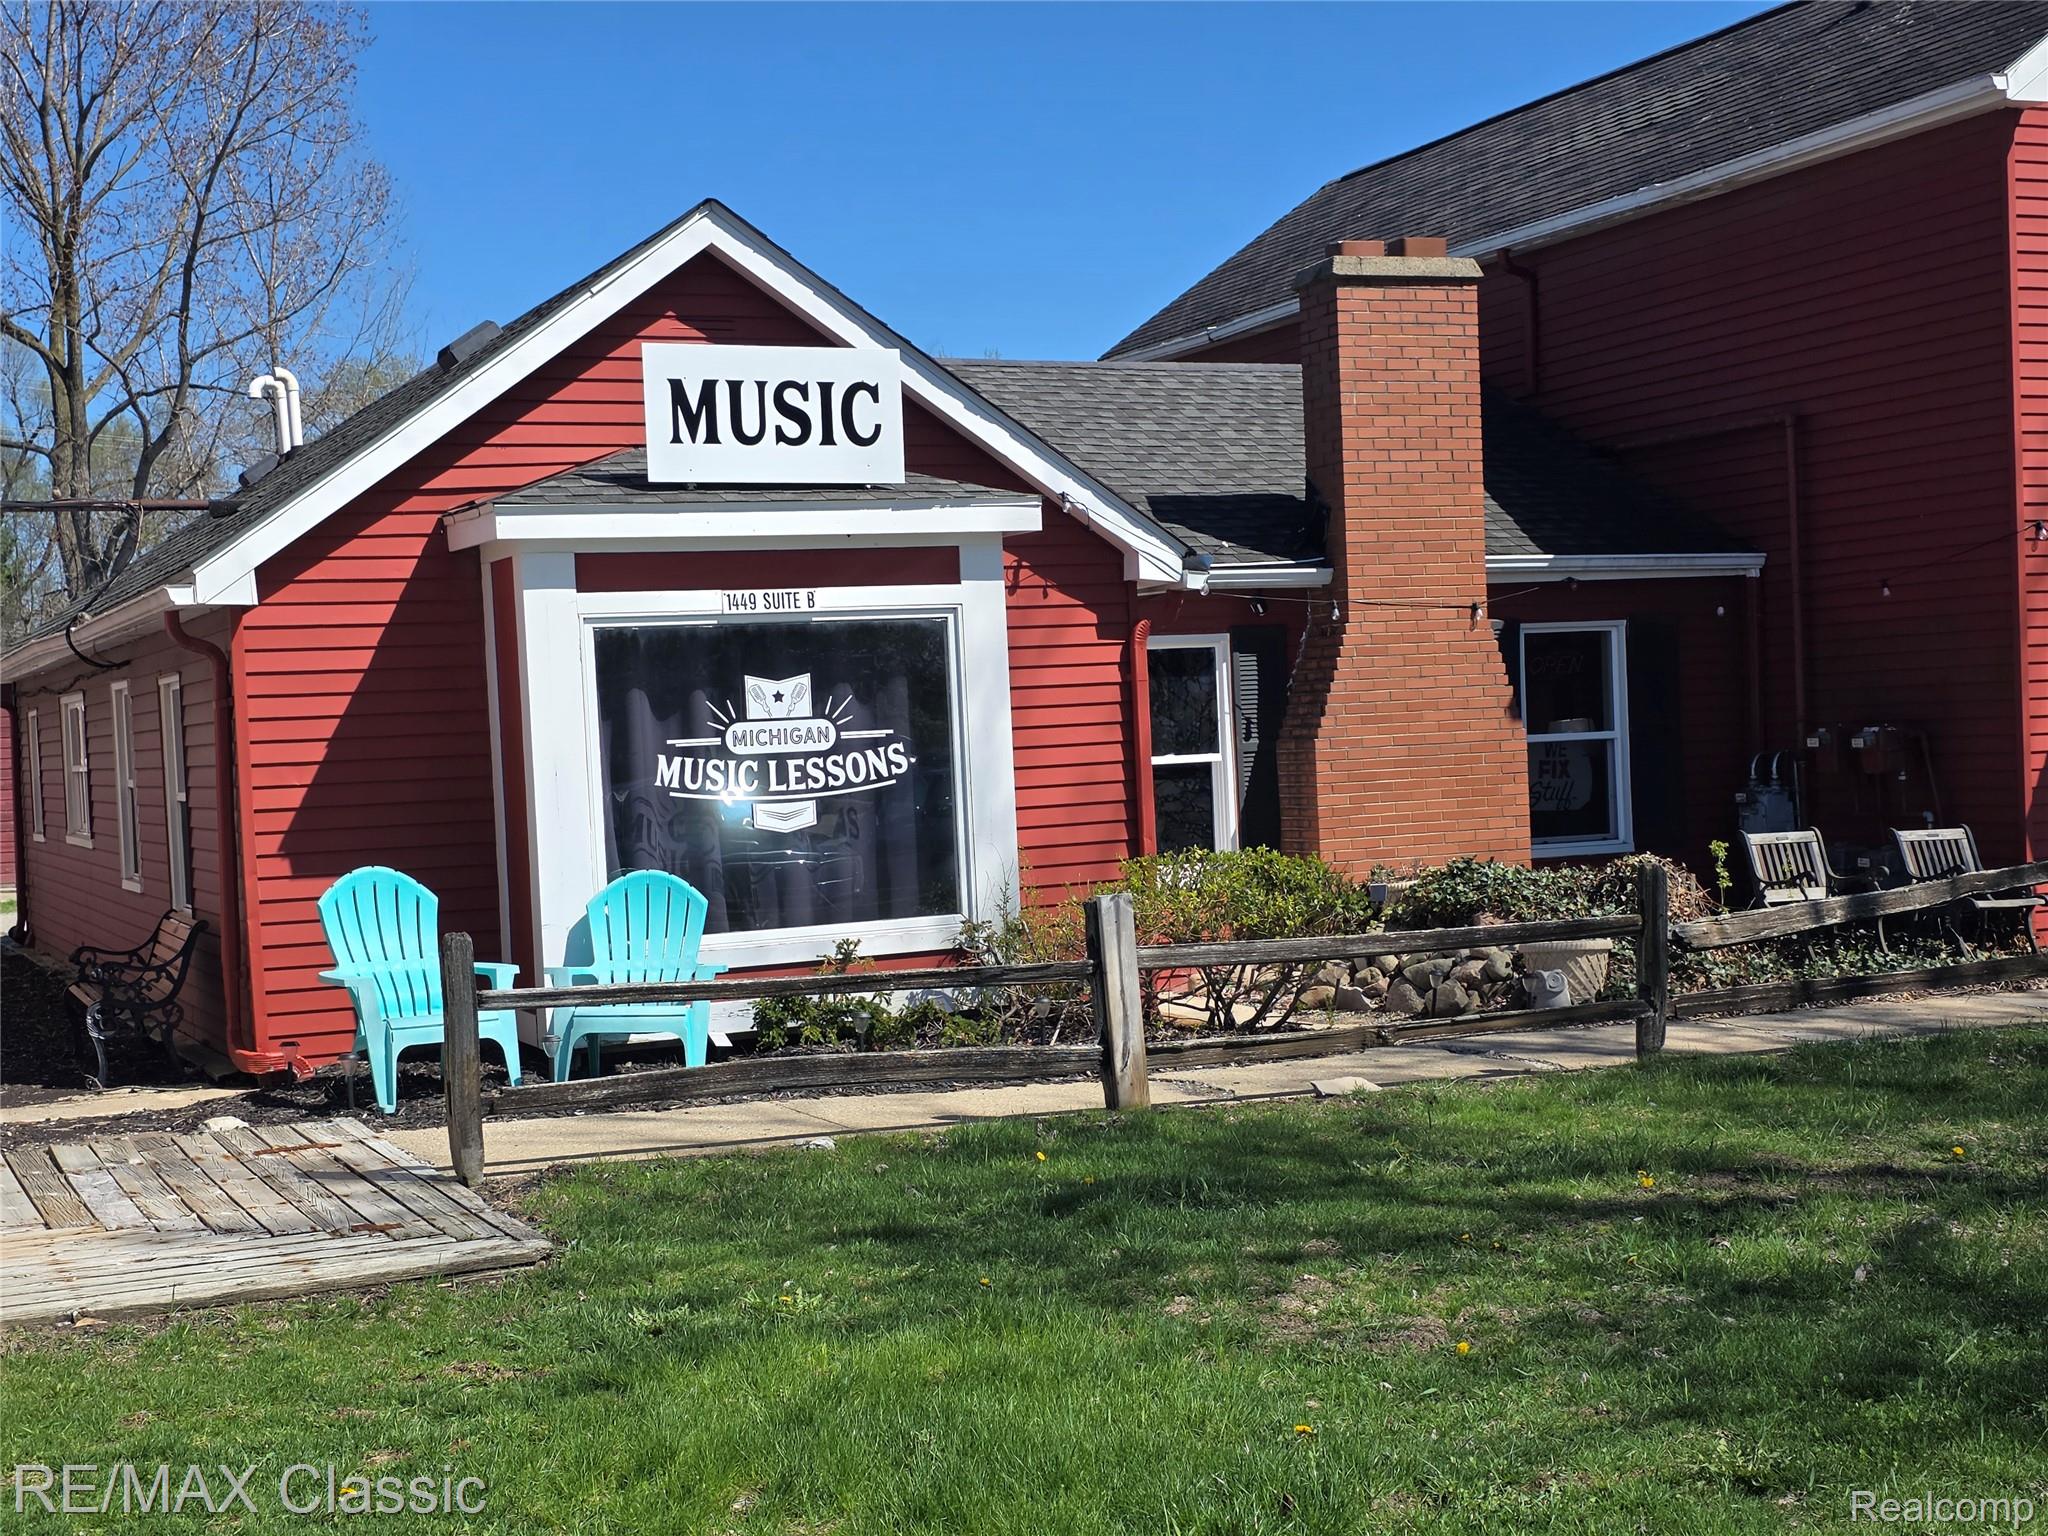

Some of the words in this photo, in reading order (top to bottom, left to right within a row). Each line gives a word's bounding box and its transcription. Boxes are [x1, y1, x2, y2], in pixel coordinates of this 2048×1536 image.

[667, 378, 882, 447] MUSIC
[726, 592, 757, 611] 1449
[763, 591, 801, 610] SUITE
[807, 591, 815, 609] B
[1530, 655, 1584, 675] OPEN
[732, 726, 830, 747] MICHIGAN
[1544, 743, 1567, 758] WE
[654, 754, 759, 793] MUSIC
[768, 742, 909, 792] LESSONS
[1538, 760, 1570, 779] FIX
